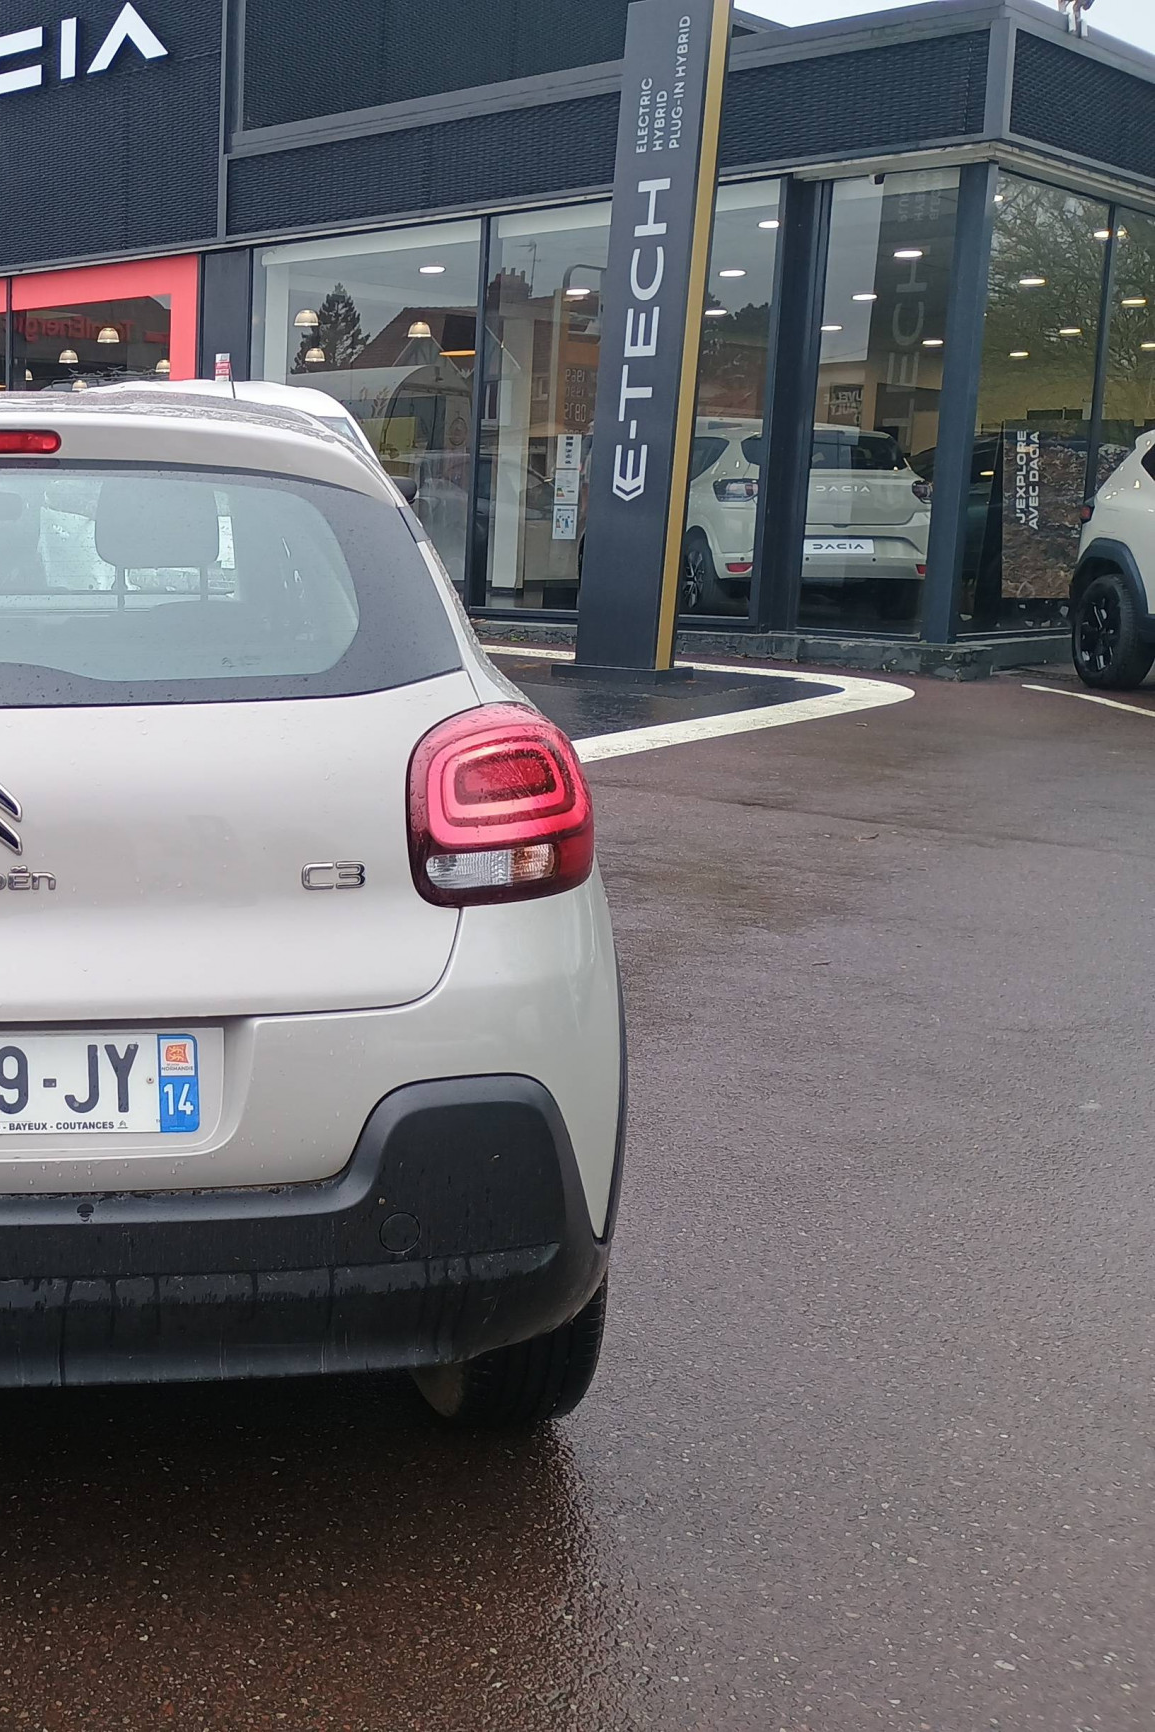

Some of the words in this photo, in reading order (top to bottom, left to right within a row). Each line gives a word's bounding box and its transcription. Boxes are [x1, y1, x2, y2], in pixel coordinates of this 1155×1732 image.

[675, 15, 691, 78] HYBRID
[635, 77, 653, 154] ELECTRIC
[652, 90, 668, 151] HYBRID
[669, 81, 686, 149] PLUG-IN
[612, 177, 671, 501] E-TECH
[1015, 430, 1028, 524] J'EXPLORE
[1029, 431, 1040, 482] DACIA
[815, 485, 871, 493] DACIA
[1028, 485, 1040, 531] AVEC
[301, 860, 367, 891] C3
[8, 1122, 47, 1131] BAYEUX
[55, 1121, 115, 1131] COUTANCES
[163, 1083, 194, 1115] 14
